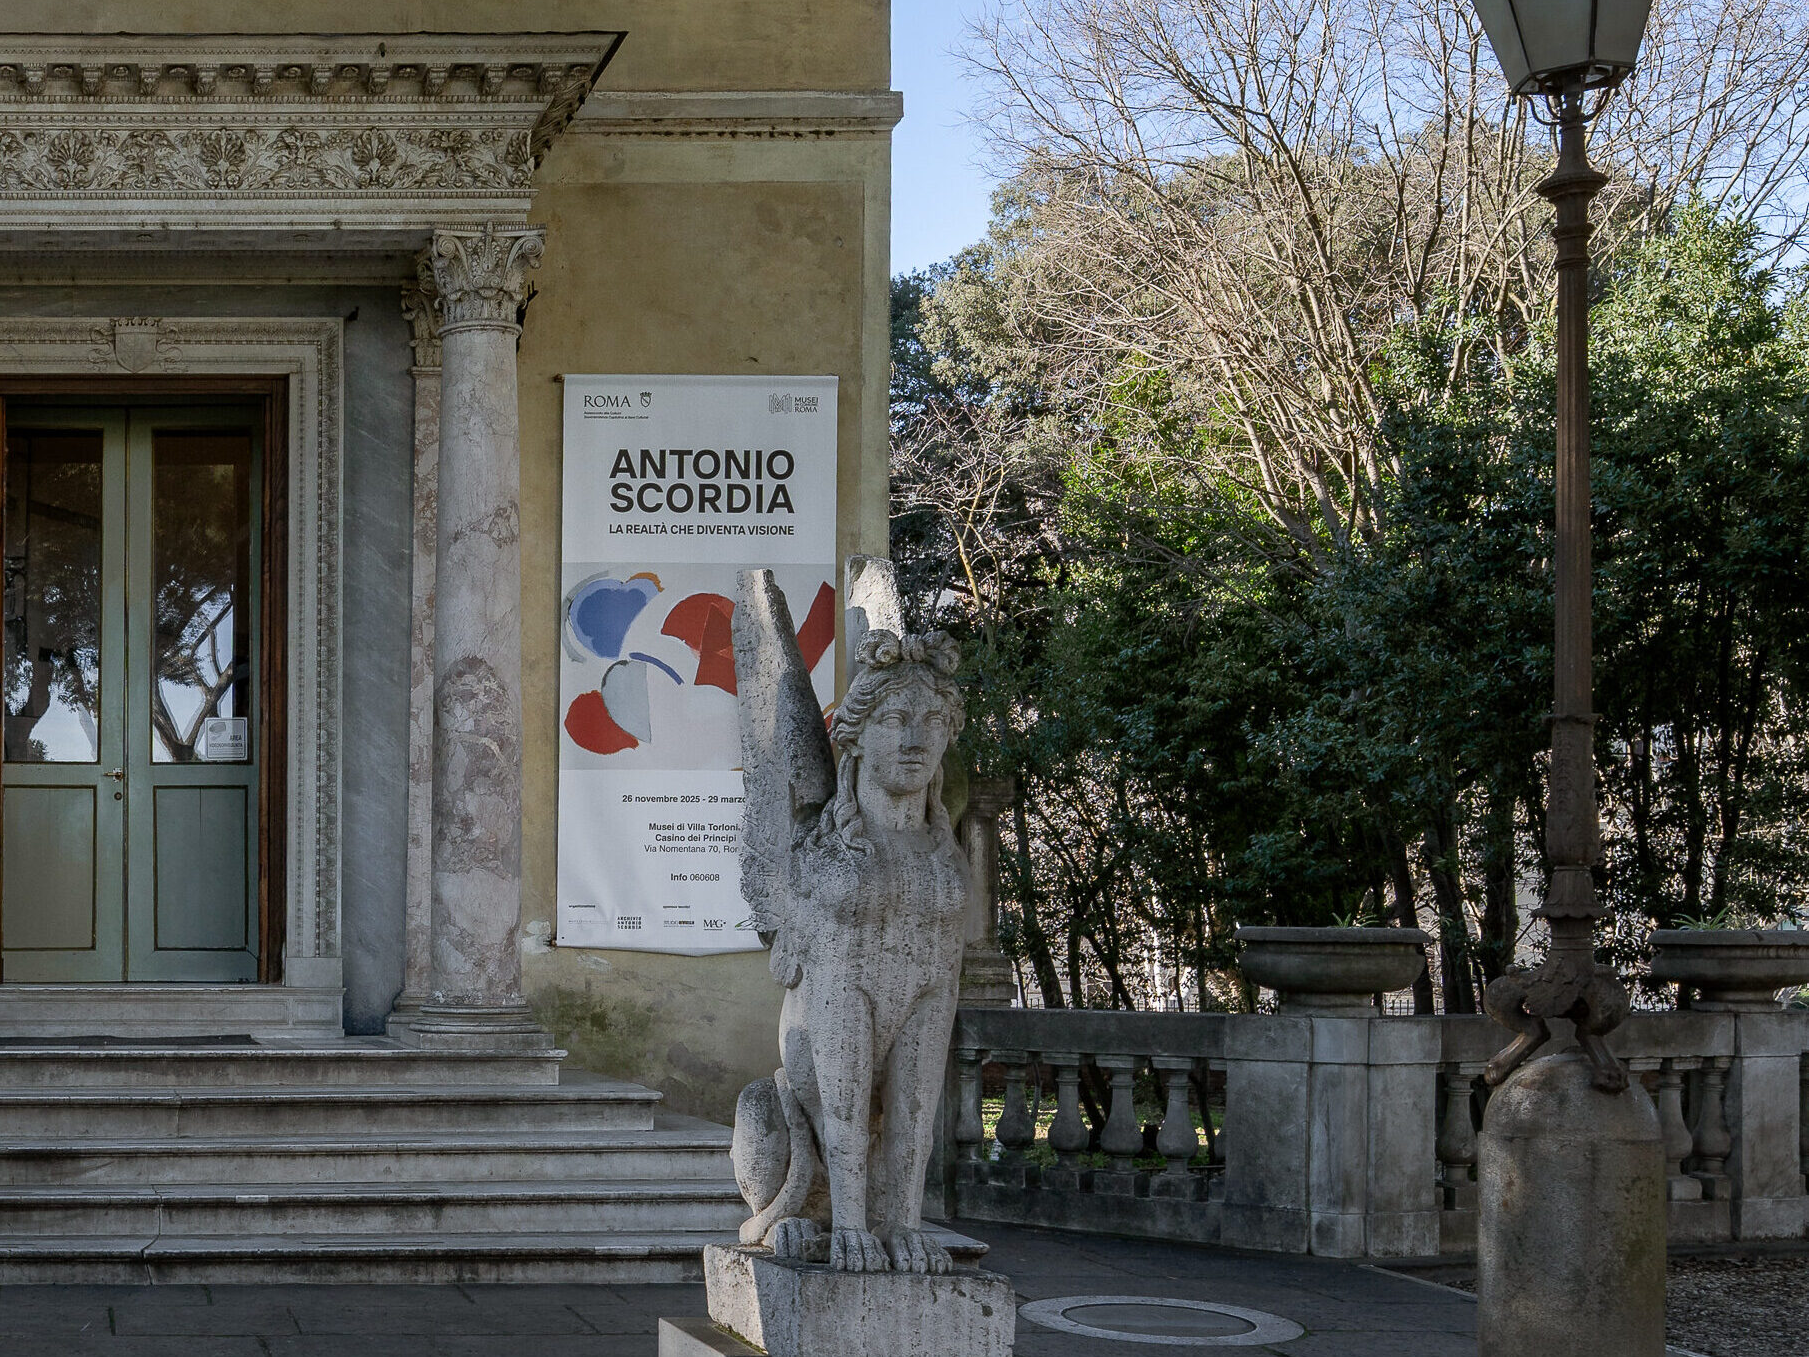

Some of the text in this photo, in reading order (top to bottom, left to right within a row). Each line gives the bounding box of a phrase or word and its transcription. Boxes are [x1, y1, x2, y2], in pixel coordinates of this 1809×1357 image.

[584, 395, 631, 408] ROMA
[609, 449, 795, 480] ANTONIO
[609, 483, 795, 514] SCORDIA
[609, 522, 794, 535] LA REALTÀ CHE DIVENTA VISIONE
[622, 795, 632, 803] 26
[635, 795, 678, 803] novembre
[680, 795, 700, 803] 2025
[649, 823, 674, 831] Musei
[677, 823, 685, 831] di
[687, 823, 705, 831] Villa
[703, 835, 737, 844] Principi
[644, 845, 657, 853] Via
[659, 845, 705, 853] Nomentana
[708, 846, 721, 854] 70,
